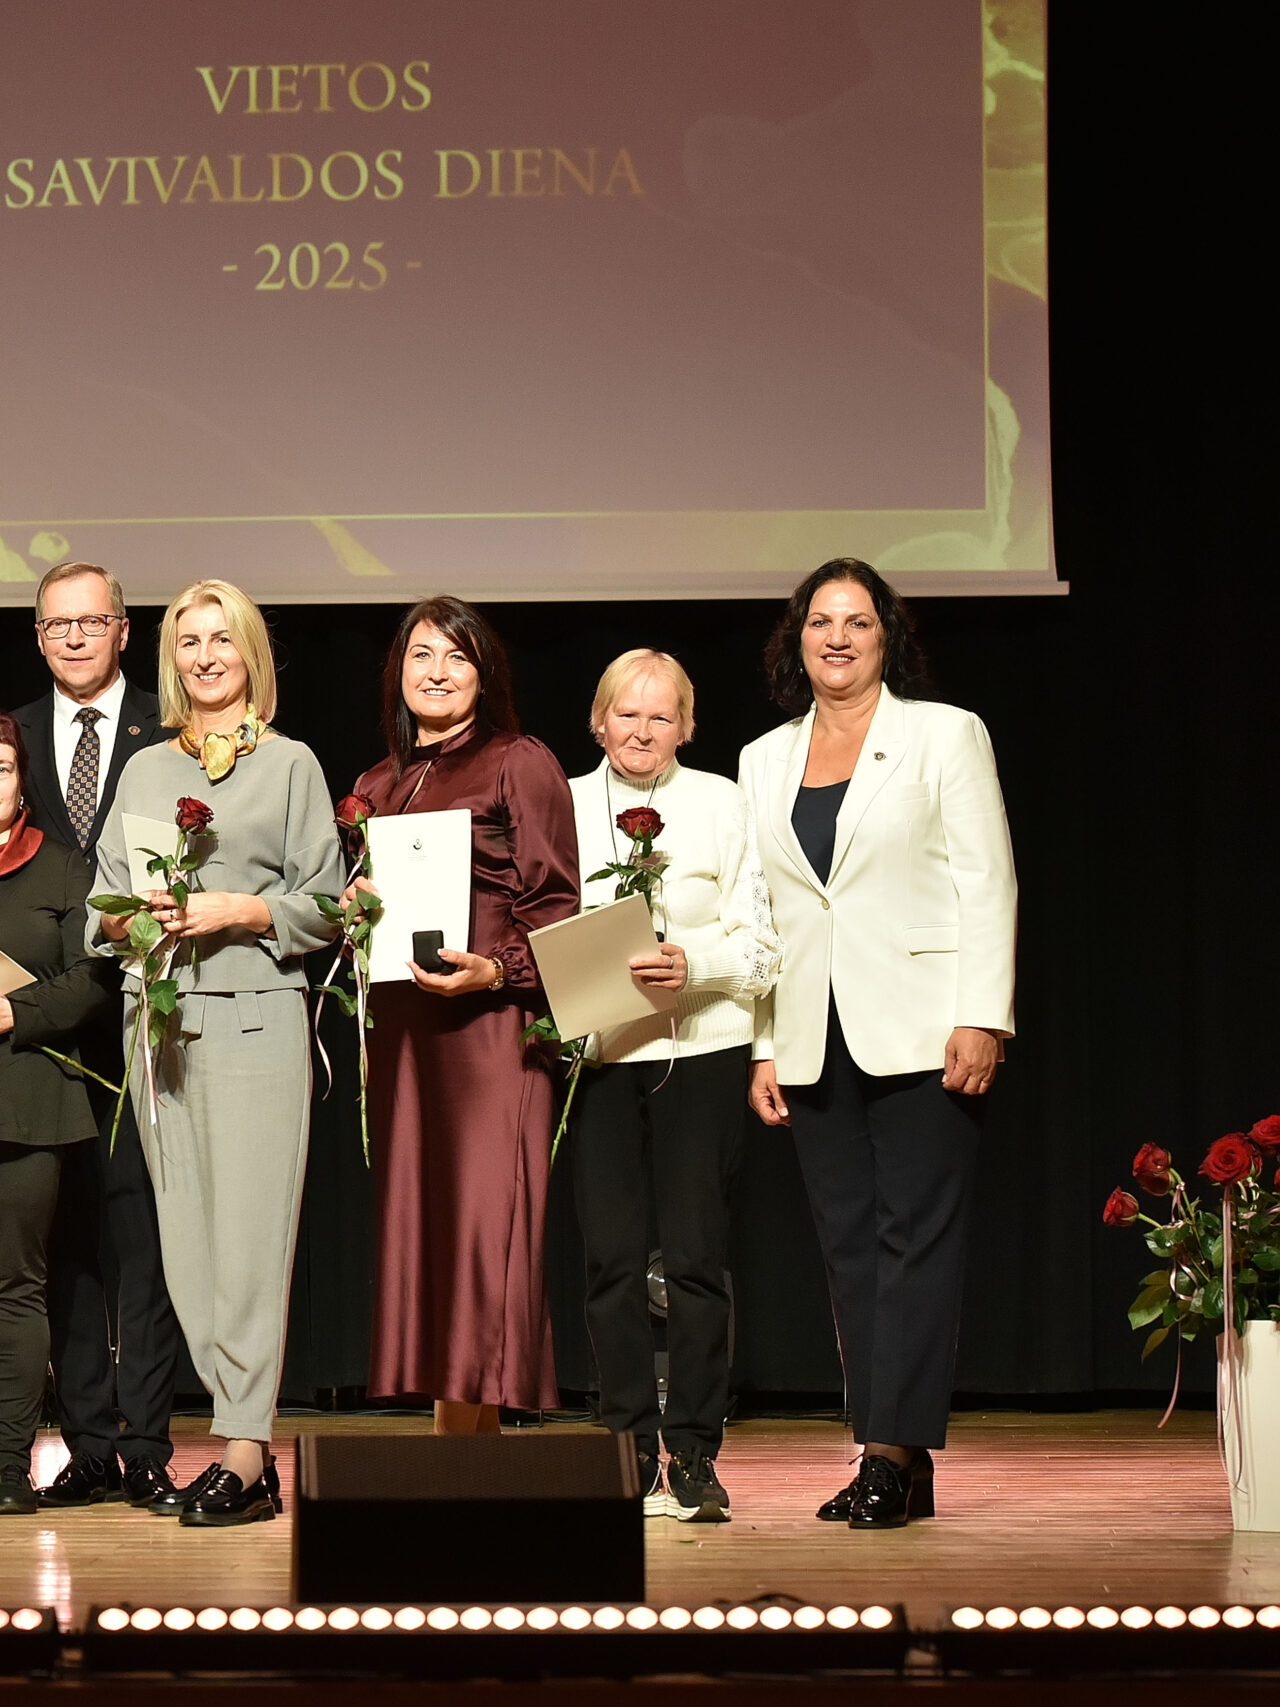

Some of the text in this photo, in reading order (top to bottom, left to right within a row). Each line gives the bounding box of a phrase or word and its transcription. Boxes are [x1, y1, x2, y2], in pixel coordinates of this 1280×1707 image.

[195, 61, 432, 114] VIETOS
[5, 147, 645, 209] SAVIVALDOS DIENA
[254, 242, 388, 291] 2025
